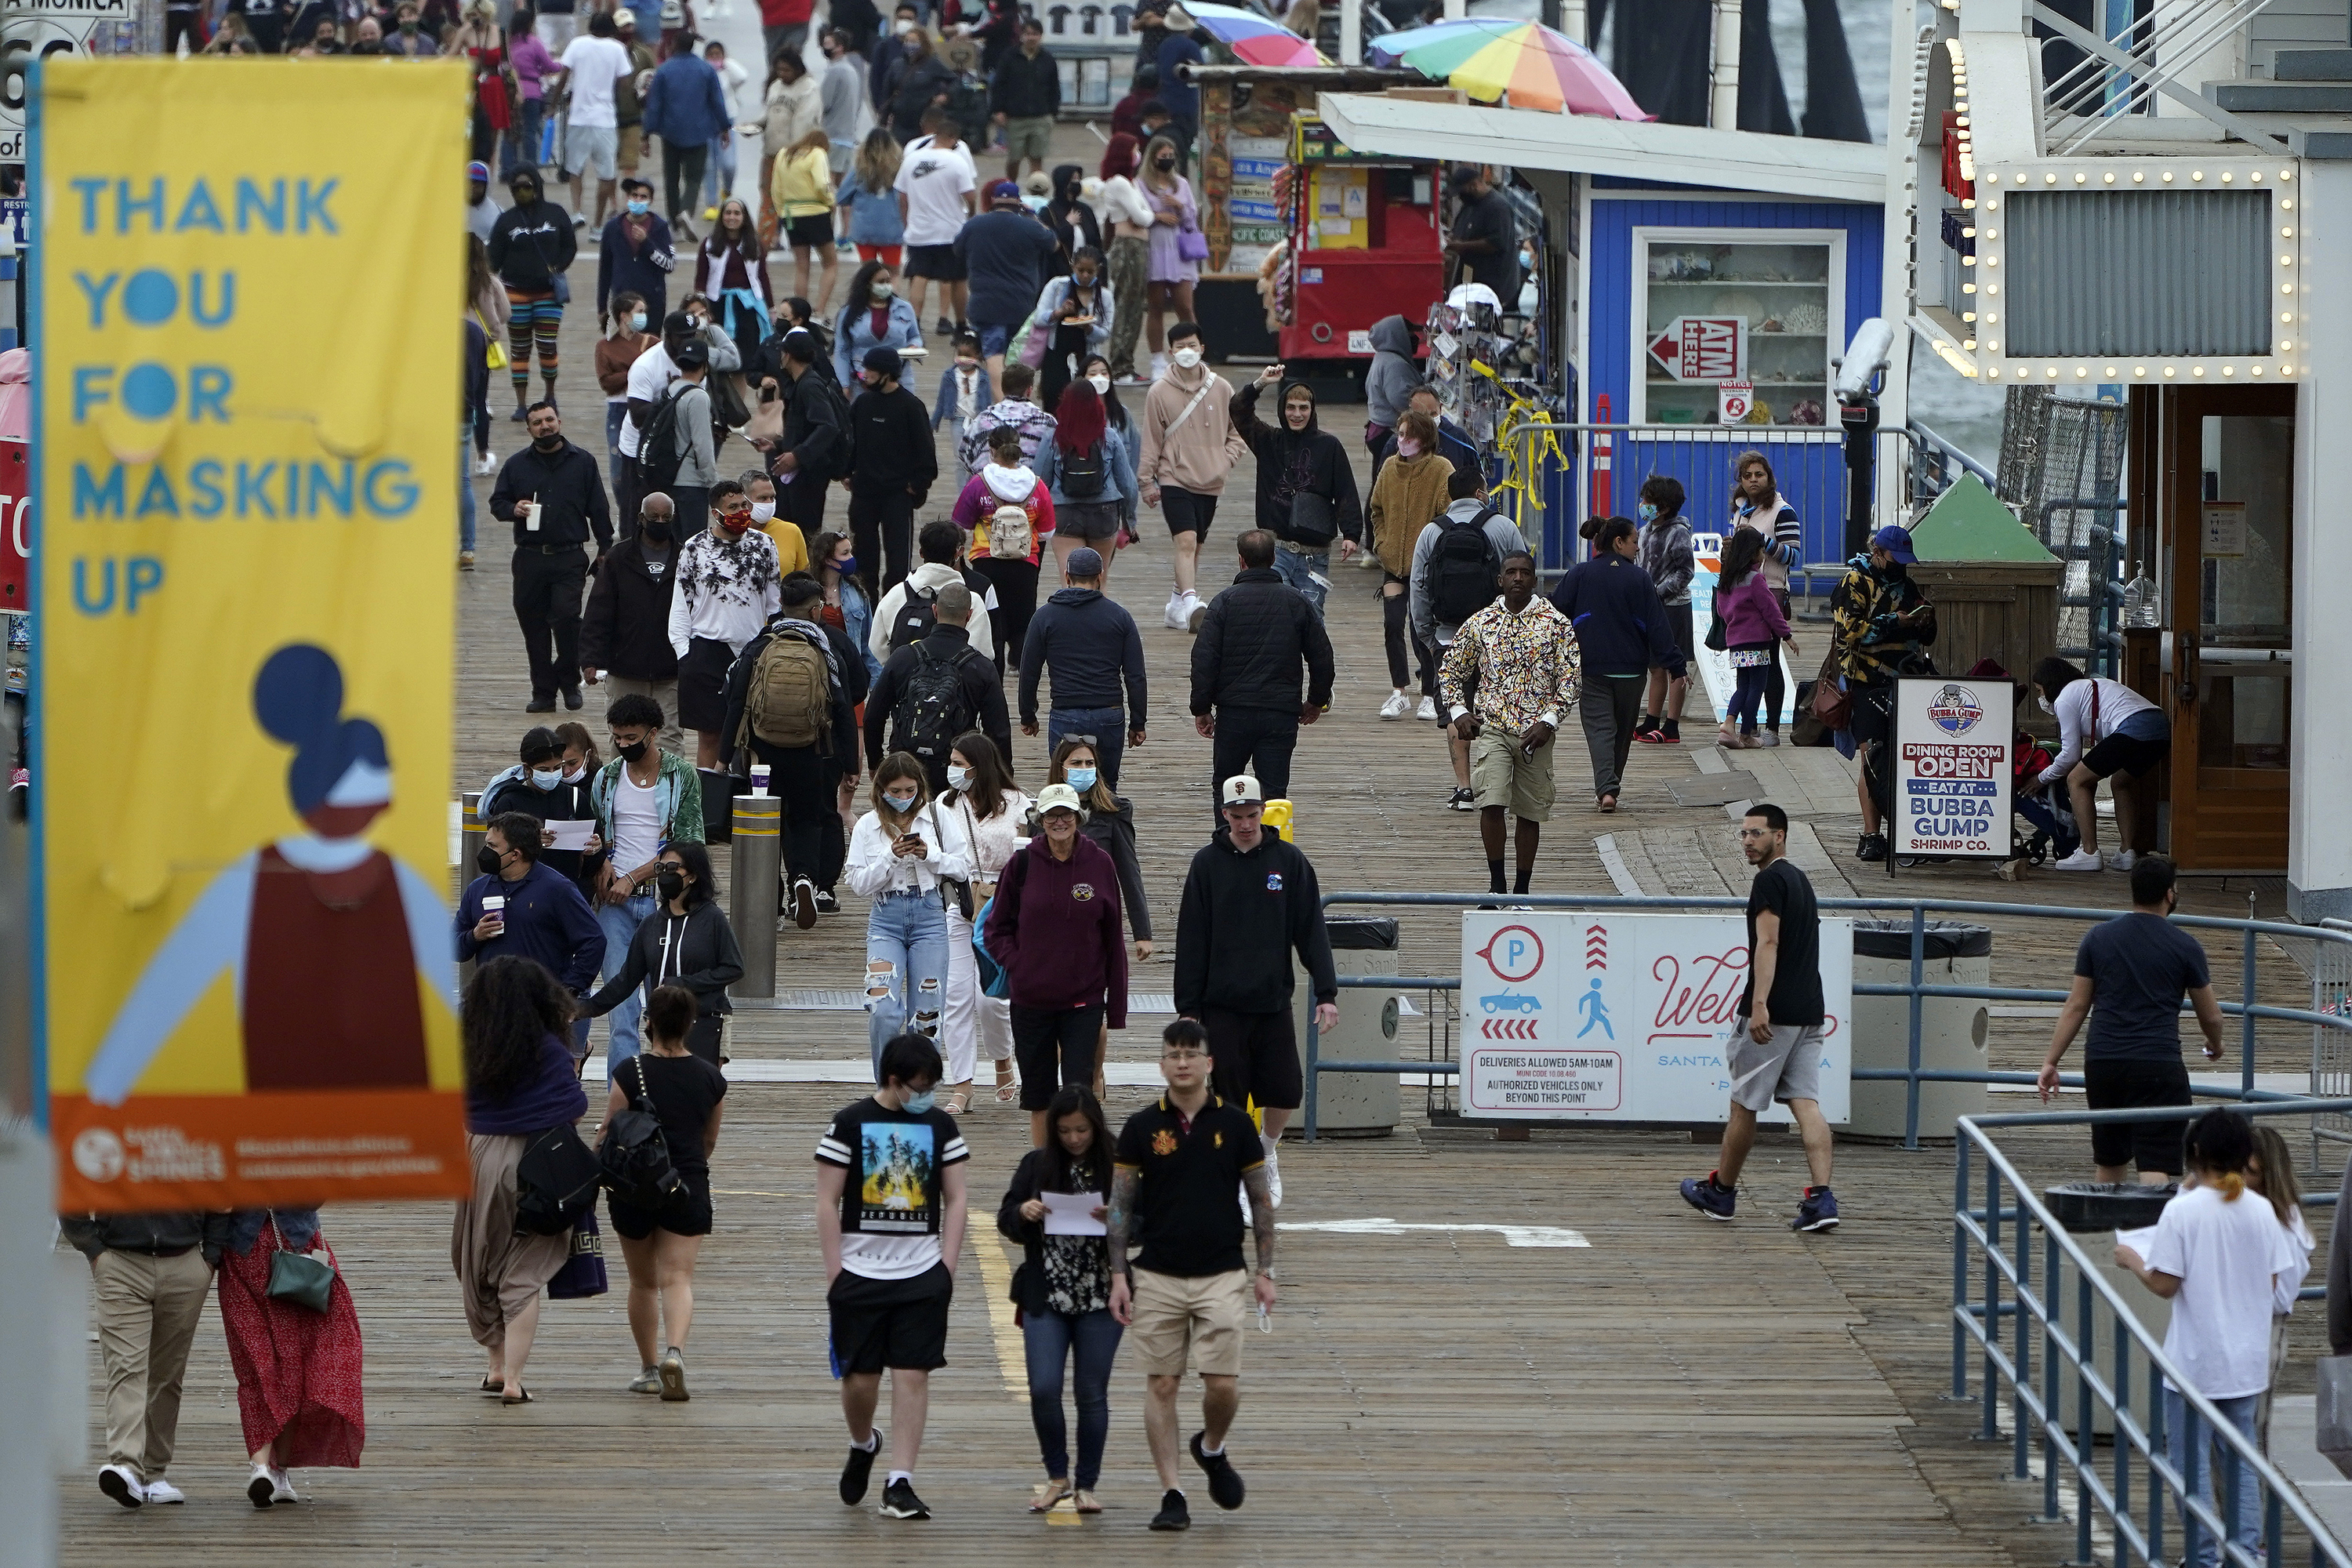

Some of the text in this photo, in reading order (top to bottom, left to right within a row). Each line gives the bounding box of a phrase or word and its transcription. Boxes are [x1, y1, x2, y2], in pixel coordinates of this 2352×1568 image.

[0, 133, 21, 155] of
[69, 176, 341, 234] THANK
[73, 267, 236, 328] YOU
[1684, 322, 1698, 376] HERE
[1700, 321, 1733, 378] ATM
[71, 361, 232, 424] FOR
[72, 457, 422, 519] MASKING
[72, 555, 165, 616] UP
[1929, 707, 1981, 719] BUBBA GUMP
[1906, 745, 2001, 758] DINING ROOM
[1918, 757, 1990, 778] OPEN
[1929, 782, 1976, 794] EAT AT
[1911, 797, 1994, 817] BUBBA
[1914, 818, 1989, 837] GUMP
[1910, 839, 1991, 851] SHRIMP CO.
[1508, 940, 1525, 967] P
[1480, 1057, 1613, 1069] DELIVERIES ALLOWED 5AM-10AM
[1658, 1056, 1722, 1066] SANTA
[1487, 1080, 1603, 1091] AUTHORIZED VEHICLES ONLY
[1506, 1093, 1586, 1103] BEYOND THIS POINT
